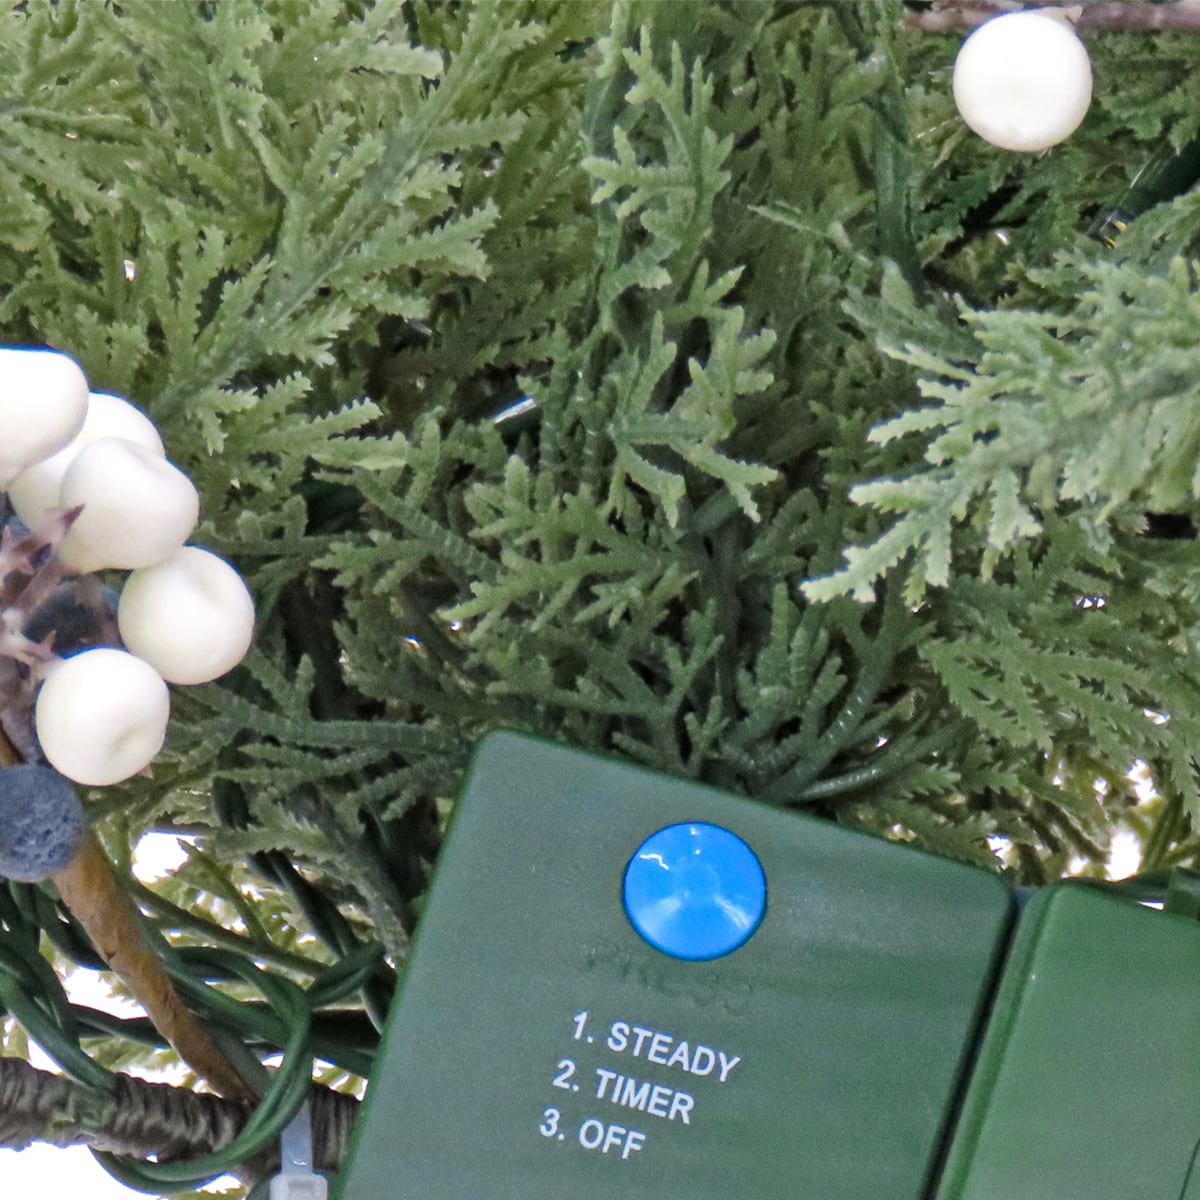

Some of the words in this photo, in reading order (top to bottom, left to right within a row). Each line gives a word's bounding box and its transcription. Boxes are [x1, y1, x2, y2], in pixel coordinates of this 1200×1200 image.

[573, 1011, 594, 1043] 1.
[607, 1021, 741, 1082] STEADY
[552, 1059, 579, 1091] 2.
[596, 1068, 695, 1125] TIMER
[539, 1108, 565, 1140] 3.
[578, 1119, 646, 1159] OFF
